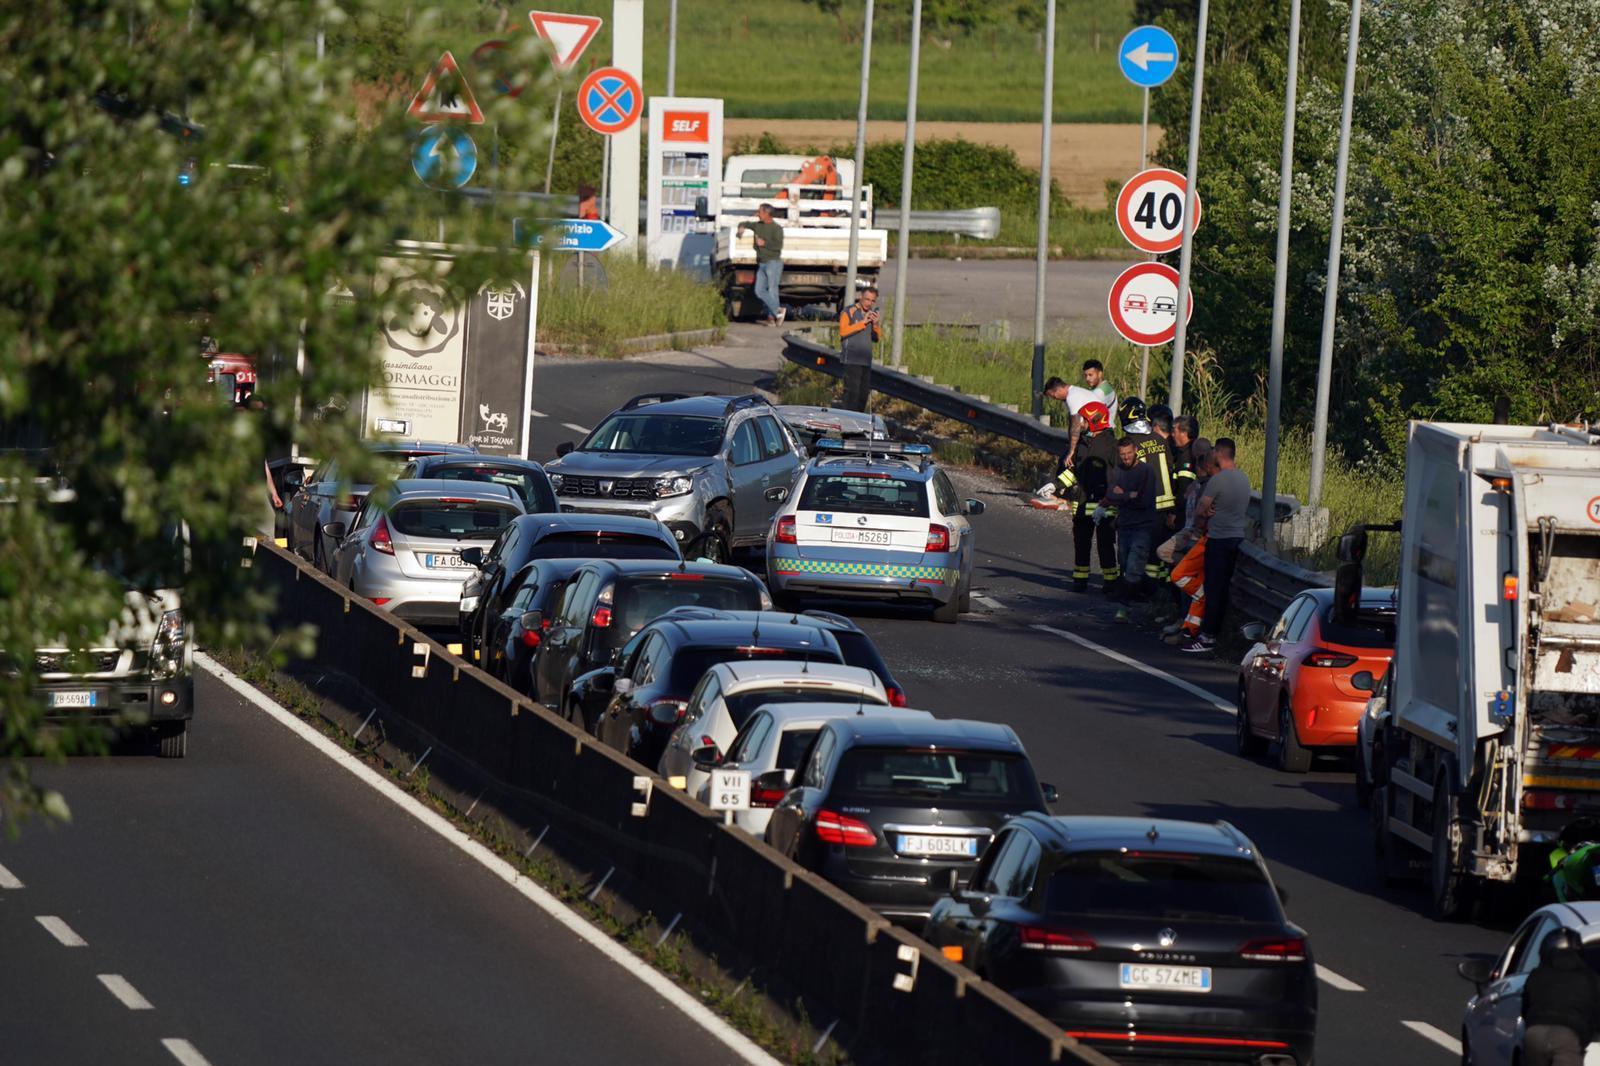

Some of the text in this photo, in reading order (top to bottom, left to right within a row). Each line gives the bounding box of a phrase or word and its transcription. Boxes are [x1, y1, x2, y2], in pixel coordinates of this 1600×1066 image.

[671, 119, 701, 132] SELF
[1134, 191, 1183, 231] 40
[383, 371, 457, 387] ORMAGGI
[858, 531, 888, 543] M5269
[434, 555, 447, 566] FA
[721, 794, 740, 805] 65
